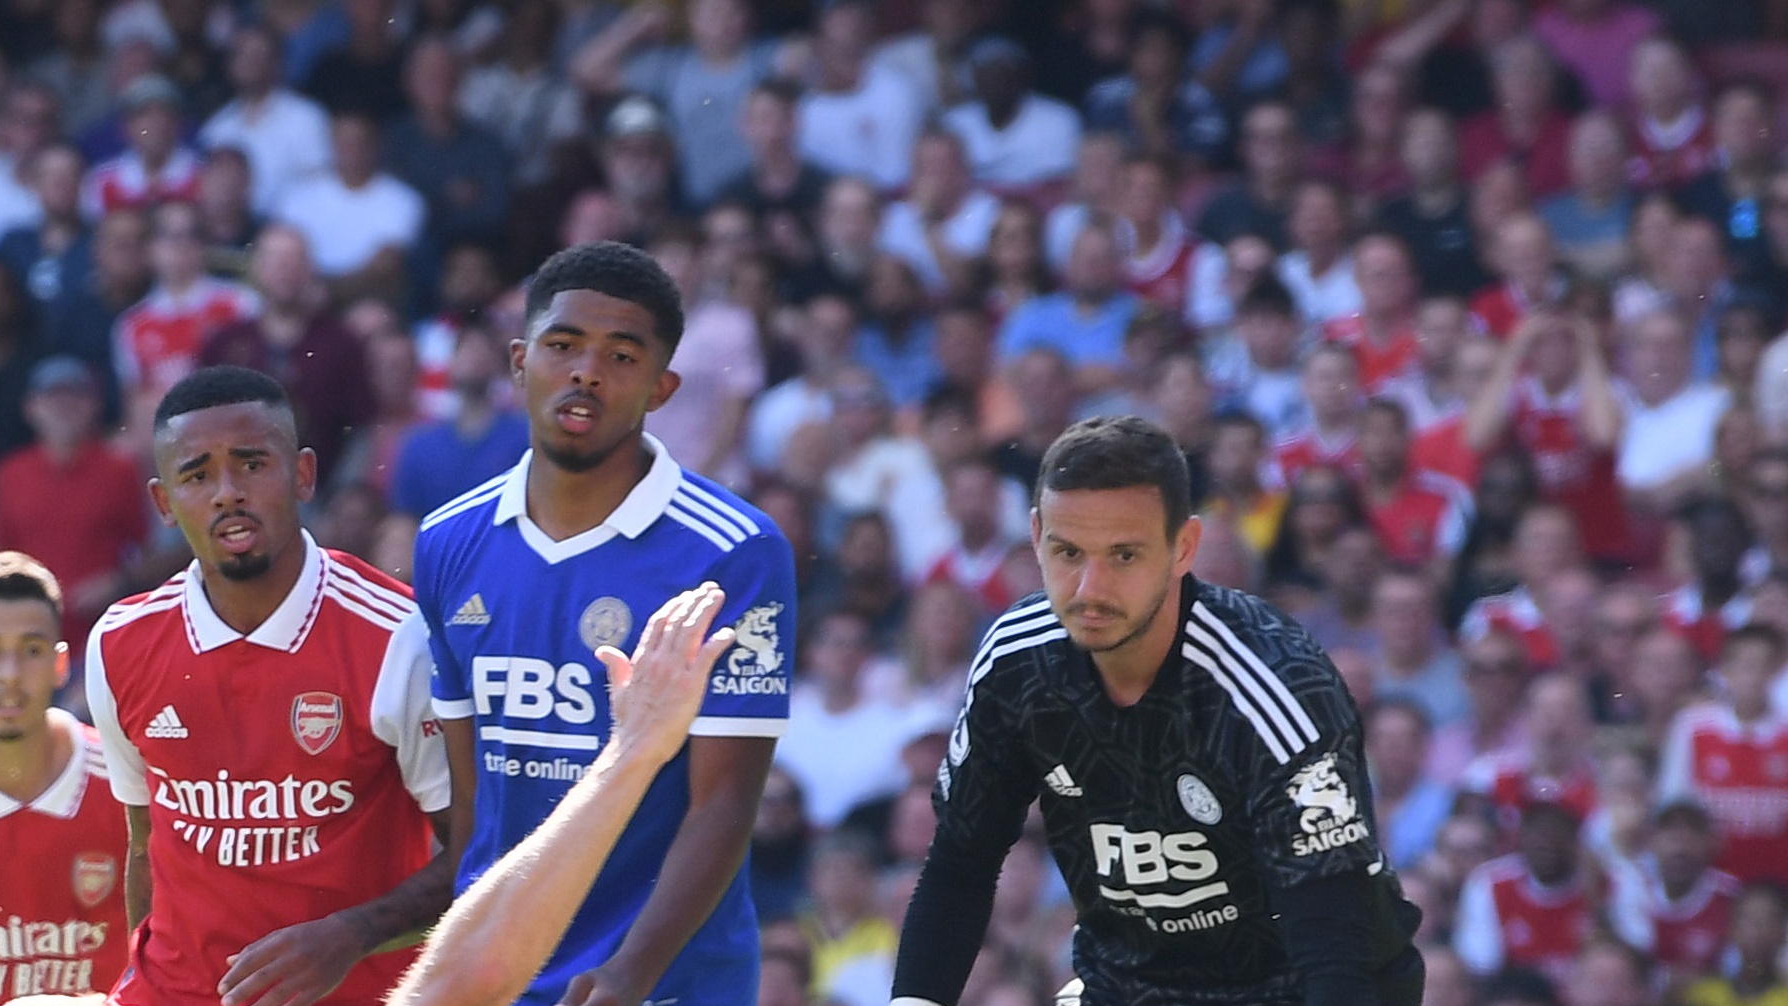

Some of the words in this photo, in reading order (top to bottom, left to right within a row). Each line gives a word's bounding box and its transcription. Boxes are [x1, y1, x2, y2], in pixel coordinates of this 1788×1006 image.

[473, 656, 596, 724] FBS
[712, 675, 788, 695] SAIGON
[218, 824, 320, 867] BETTER
[1090, 823, 1219, 885] FBS
[1291, 821, 1369, 857] SAIGON
[1162, 904, 1239, 933] online
